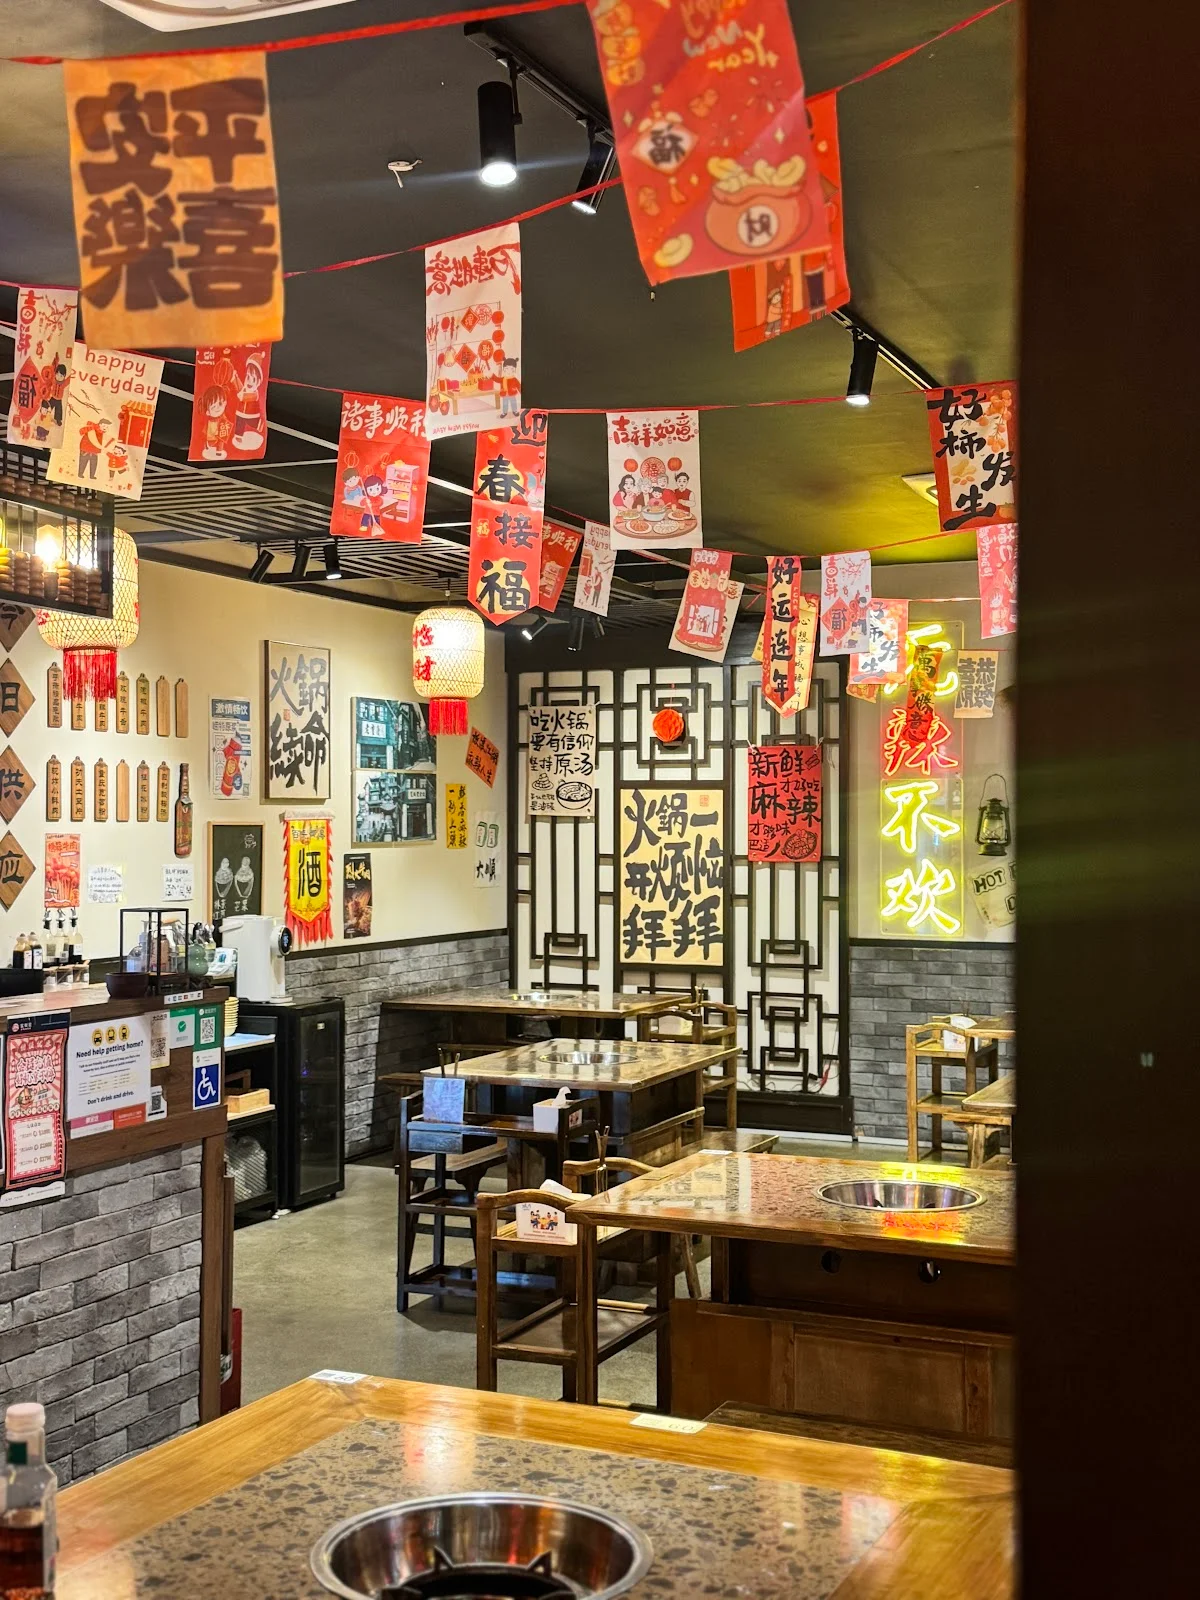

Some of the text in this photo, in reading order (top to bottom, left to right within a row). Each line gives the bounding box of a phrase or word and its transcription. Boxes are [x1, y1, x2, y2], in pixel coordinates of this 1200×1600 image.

[85, 348, 146, 377] happy
[69, 368, 158, 401] everyday
[612, 412, 695, 448] 吉祥如意
[475, 408, 548, 614] 迎春接福
[542, 523, 580, 553] 事顺利
[770, 557, 799, 702] 好运连年
[270, 654, 330, 716] 火鍋
[215, 702, 249, 716] 激情畅饮
[530, 709, 589, 732] 吃火锅
[530, 732, 594, 752] 要有信仰
[530, 752, 594, 777] 坚持原汤
[748, 746, 806, 778] 新鲜
[748, 781, 822, 828] 麻辣
[297, 847, 321, 900] 酒
[974, 869, 1003, 893] HOT
[623, 895, 723, 962] 拜拜
[76, 1040, 144, 1058] Need help getting home?
[87, 1090, 134, 1105] Don't drink and drive.
